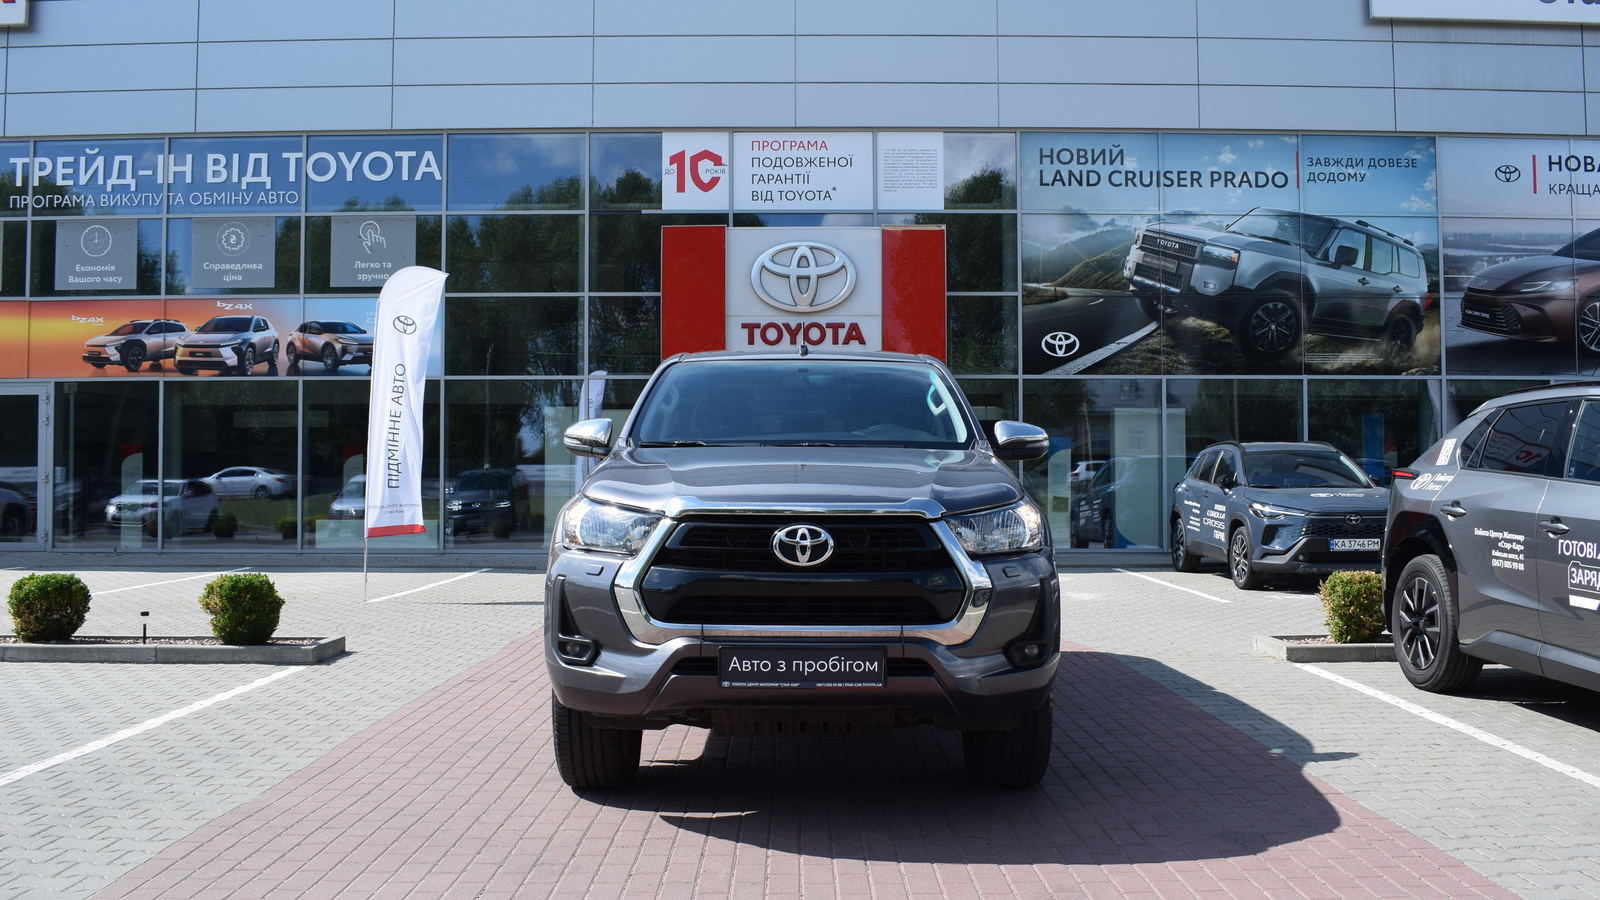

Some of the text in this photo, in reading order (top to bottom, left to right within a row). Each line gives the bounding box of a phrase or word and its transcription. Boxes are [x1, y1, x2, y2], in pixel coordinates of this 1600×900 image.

[752, 140, 828, 151] ПРОГРАМА
[1038, 144, 1124, 166] НОВИЙ
[752, 154, 853, 170] ПОДОВЖЕНОЇ
[1307, 156, 1418, 171] ЗАВЖДИ ДОВЕЗЕ
[1548, 155, 1600, 172] НОВ
[10, 148, 442, 191] ТРЕЙД-ІН ВІД TOYOTA
[752, 171, 810, 184] ГАРАНТІЇ
[1038, 170, 1289, 190] LAND CRUISER PRADO
[1307, 172, 1366, 185] ДОДОМУ
[10, 190, 299, 208] ПРОГРАМА ВИКУПУ ТА ОБМІНУ АВТО
[752, 190, 774, 202] ВІД
[1157, 239, 1179, 249] TOYOTA
[76, 264, 116, 274] Економія
[204, 262, 262, 272] Справедлива
[69, 276, 122, 286] Вашого часу
[224, 274, 242, 282] ціна
[357, 274, 389, 282] зручно
[742, 323, 866, 346] TOYOTA
[387, 364, 406, 489] ПІДМІННЕ АВТО
[1203, 518, 1225, 529] CROSS
[1348, 539, 1366, 548] 3746
[1558, 539, 1597, 558] ГОТОВІ
[1492, 559, 1503, 568] (067)
[1504, 560, 1512, 568] 005
[728, 656, 878, 676] Авто з пробігом
